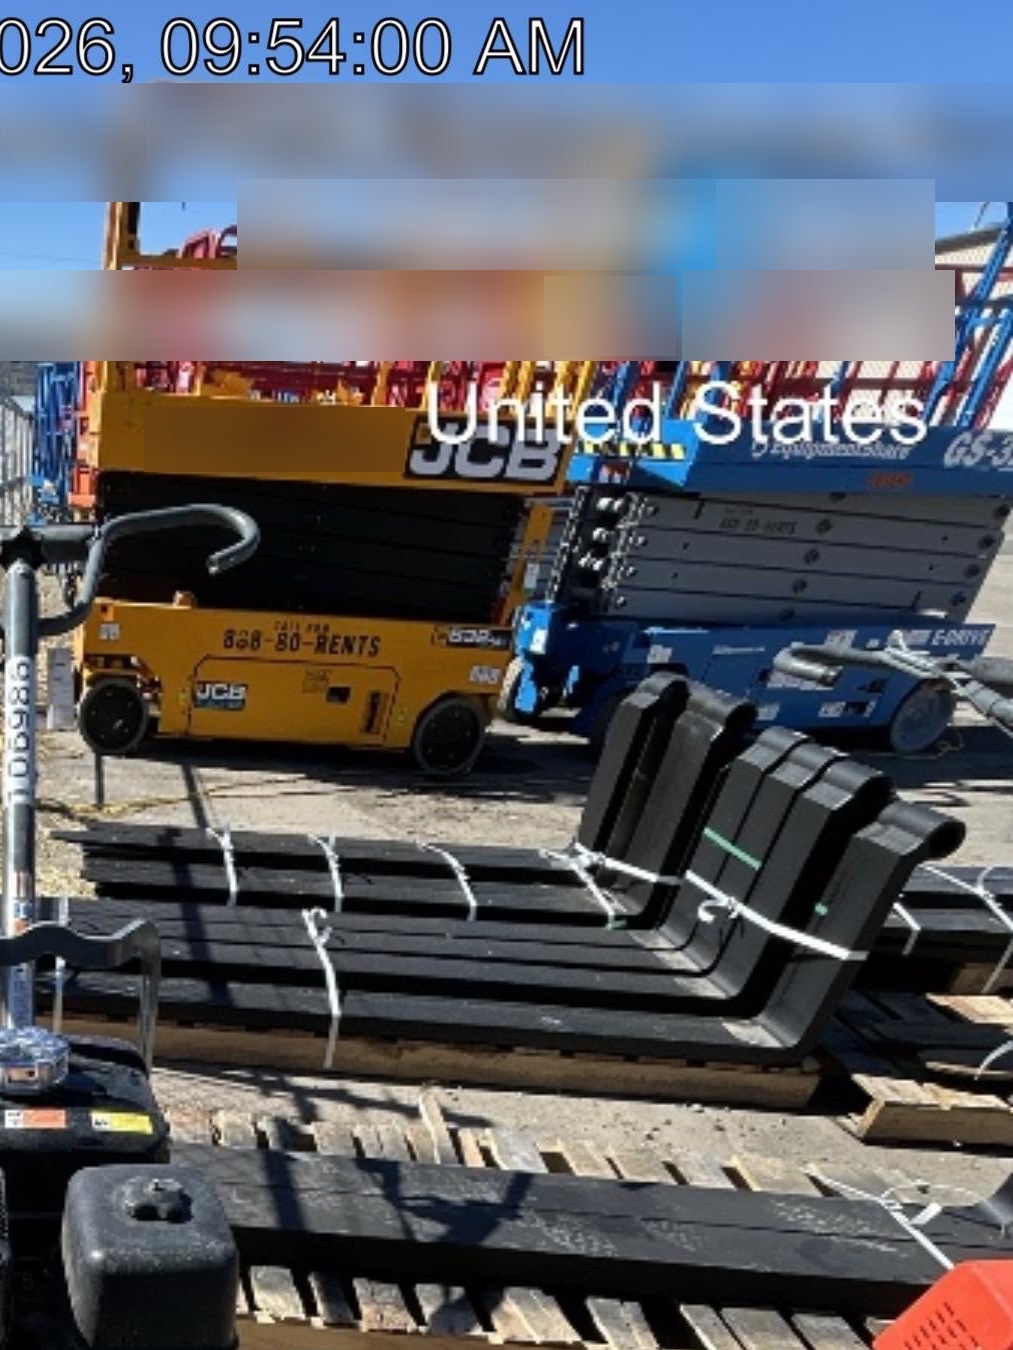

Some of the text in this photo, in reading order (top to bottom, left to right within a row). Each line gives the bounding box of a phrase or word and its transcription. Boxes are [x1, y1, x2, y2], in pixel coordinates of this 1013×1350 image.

[409, 421, 563, 480] JCB
[944, 430, 1013, 468] GS-3
[196, 682, 247, 699] JCB
